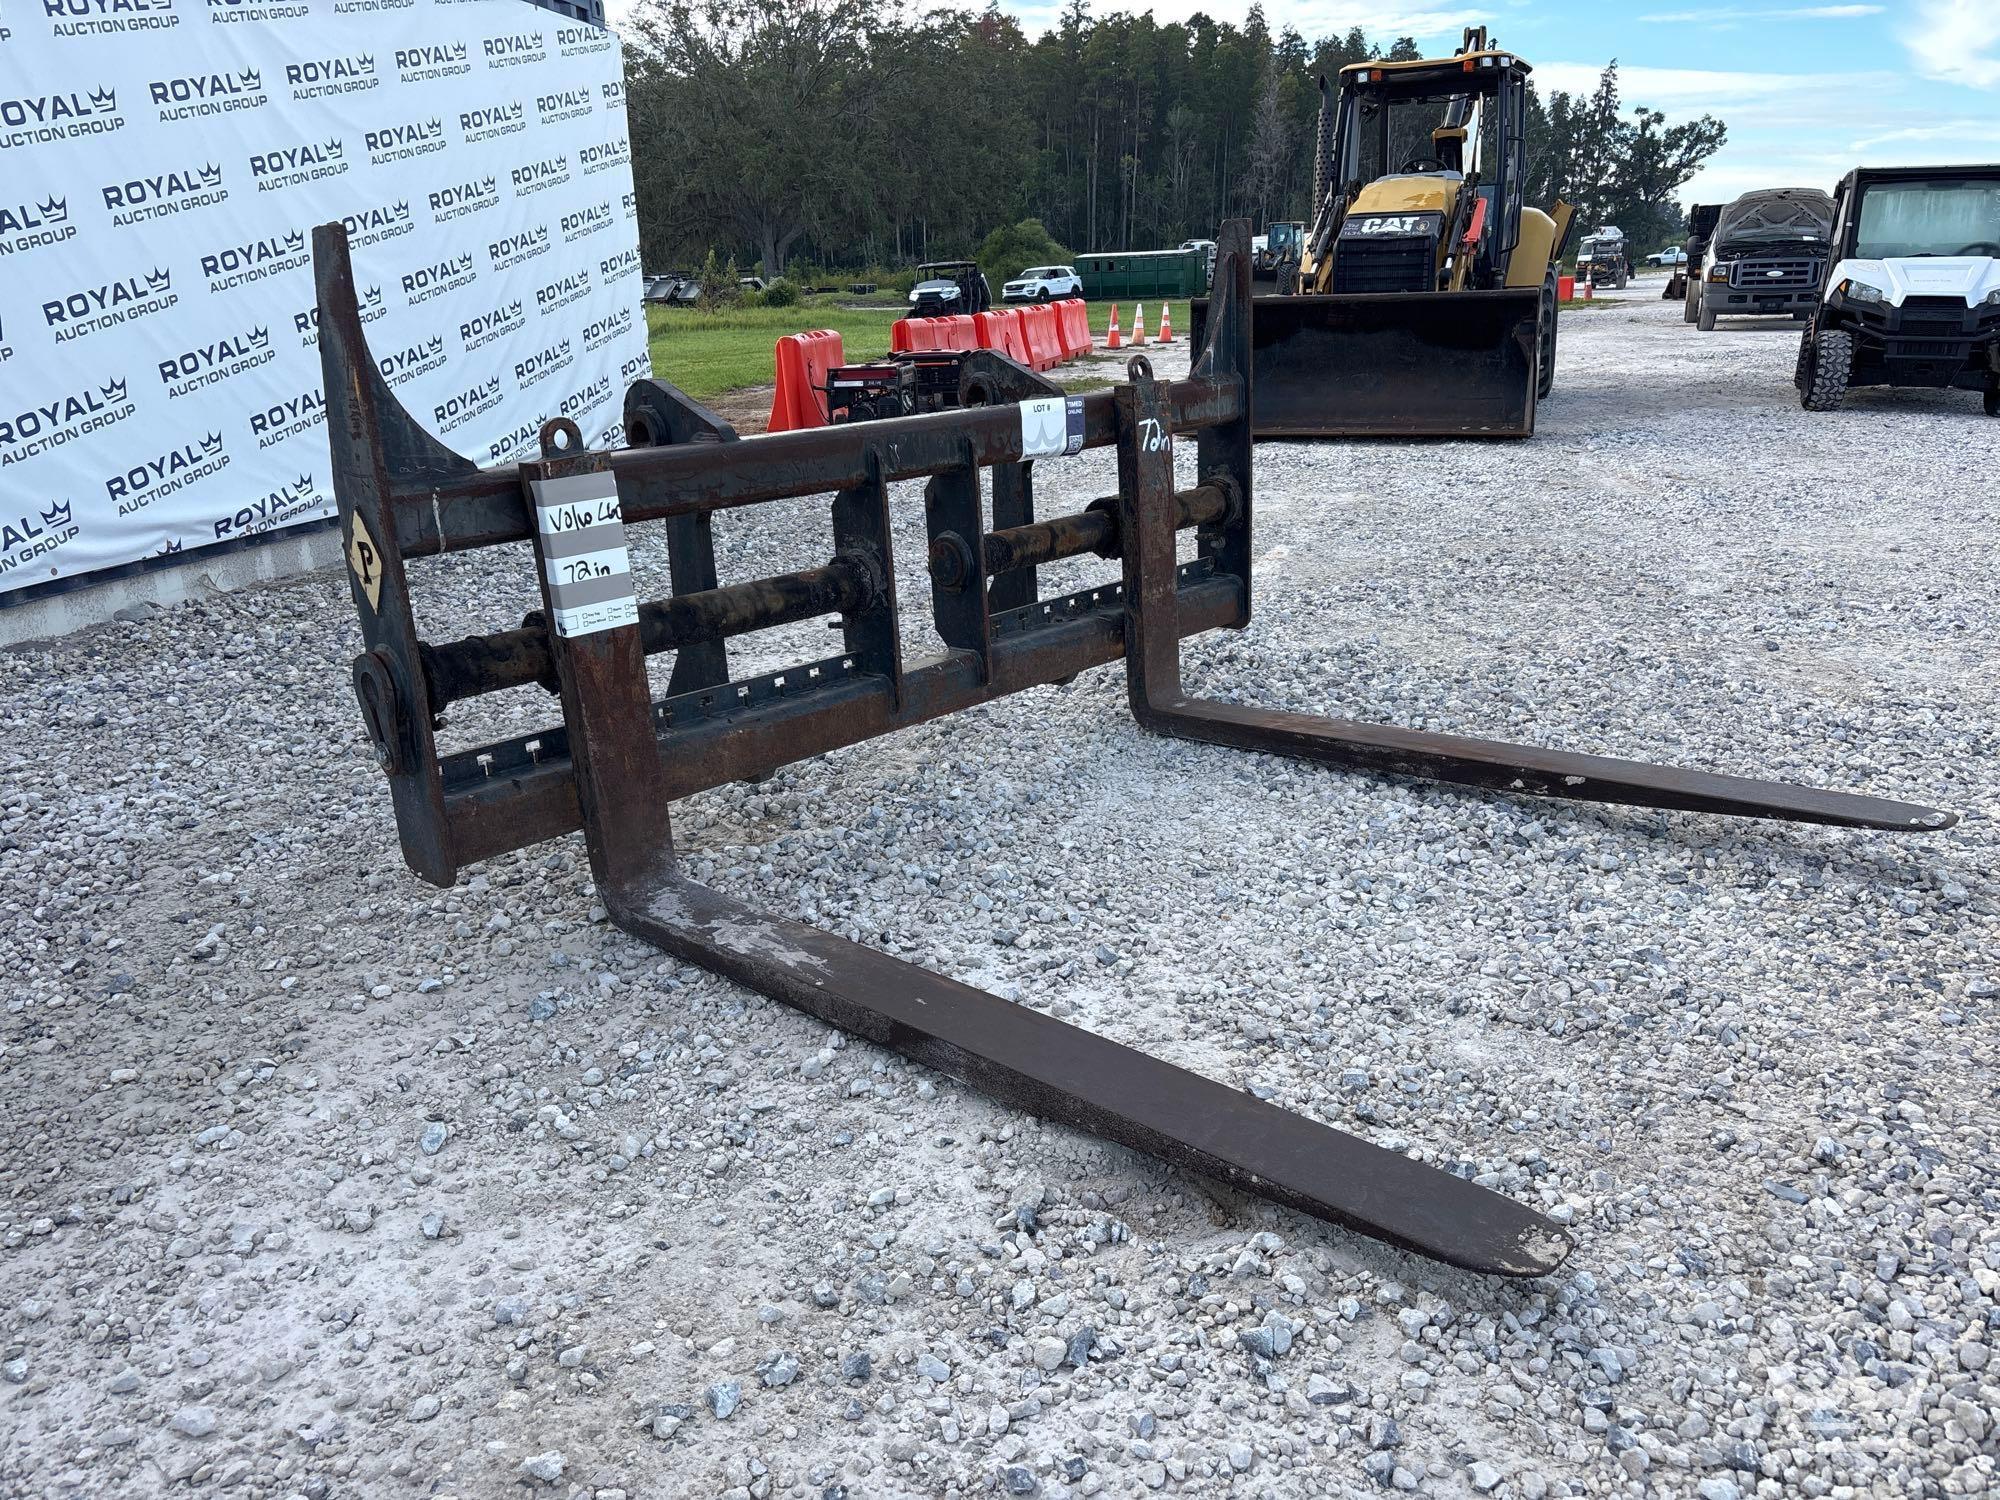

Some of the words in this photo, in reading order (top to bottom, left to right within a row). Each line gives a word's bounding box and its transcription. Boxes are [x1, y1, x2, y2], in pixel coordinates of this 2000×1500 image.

[212, 8, 269, 24] AUCTION
[268, 5, 309, 19] GROUP
[334, 0, 380, 14] AUCTION
[53, 19, 126, 37] AUCTION
[127, 15, 180, 31] GROUP
[556, 23, 600, 45] ROYAL
[394, 44, 455, 69] ROYAL
[482, 34, 533, 57] ROYAL
[488, 56, 522, 69] AUCTION
[521, 51, 547, 64] GROUP
[561, 45, 590, 57] AUCTION
[589, 42, 611, 53] GROUP
[285, 57, 360, 85] ROYAL
[400, 68, 441, 83] AUCTION
[441, 63, 471, 77] GROUP
[148, 73, 242, 105] ROYAL
[293, 83, 343, 101] AUCTION
[343, 77, 379, 93] GROUP
[536, 90, 580, 113] ROYAL
[602, 80, 625, 99] ROY
[606, 98, 626, 110] AUCTIO
[0, 93, 92, 129] OYAL
[159, 102, 222, 122] AUCTION
[222, 95, 268, 112] GROUP
[459, 105, 512, 131] ROYAL
[541, 111, 571, 125] AUCTION
[570, 105, 593, 118] GROUP
[0, 126, 66, 149] UCTION
[67, 117, 125, 137] GROUP
[364, 122, 429, 152] ROYAL
[465, 127, 500, 144] AUCTION
[500, 121, 526, 135] GROUP
[249, 144, 328, 177] ROYAL
[371, 147, 415, 166] AUCTION
[414, 140, 447, 156] GROUP
[579, 141, 620, 165] ROYAL
[583, 161, 610, 176] AUCTION
[609, 154, 629, 166] GROUP
[258, 171, 310, 193] AUCTION
[310, 162, 349, 180] GROUP
[511, 159, 557, 186] ROYAL
[516, 180, 548, 198] AUCTION
[547, 173, 570, 188] GROUP
[101, 170, 202, 210] ROYAL
[428, 181, 484, 211] ROYAL
[113, 201, 179, 228] AUCTION
[180, 189, 229, 211] GROUP
[341, 206, 395, 238] OYAL
[434, 204, 472, 224] AUCTION
[471, 195, 500, 212] GROUP
[560, 206, 602, 233] ROYAL
[15, 225, 77, 251] GROUP
[346, 232, 380, 251] CTION
[380, 222, 415, 240] GROUP
[564, 226, 592, 244] AUCTION
[591, 217, 614, 233] GROUP
[1361, 216, 1420, 233] CAT
[200, 237, 286, 278] ROYAL
[488, 230, 538, 261] ROYAL
[493, 252, 526, 273] AUCTION
[526, 242, 551, 259] GROUP
[210, 266, 268, 294] AUCTION
[268, 253, 311, 276] GROUP
[401, 259, 461, 293] ROYAL
[599, 248, 637, 275] ROYAL
[604, 268, 630, 286] AUCTION
[629, 262, 641, 274] GRO
[41, 277, 149, 326] ROYAL
[408, 284, 448, 307] AUCTION
[447, 272, 477, 291] GROUP
[535, 275, 580, 306] ROYAL
[540, 297, 570, 316] AUCTION
[569, 285, 592, 302] GROUP
[55, 310, 125, 344] AUCTION
[126, 294, 179, 320] GROUP
[359, 307, 387, 325] ROUP
[459, 306, 511, 341] ROYAL
[582, 313, 621, 343] ROYAL
[465, 329, 500, 353] AUCTION
[499, 317, 526, 336] GROUP
[585, 333, 612, 353] AUCTION
[611, 322, 632, 339] GROUP
[158, 336, 250, 384] ROYAL
[169, 366, 230, 400] AUCTION
[230, 349, 276, 375] GROUP
[379, 344, 430, 377] OYAL
[385, 369, 415, 393] CTION
[415, 354, 447, 376] GROUP
[514, 346, 561, 380] ROYAL
[519, 368, 550, 391] AUCTION
[550, 354, 574, 374] GROUP
[621, 352, 649, 378] ROYA
[433, 384, 489, 424] ROYAL
[559, 380, 601, 416] ROYAL
[568, 405, 592, 422] UCTION
[591, 390, 613, 409] GROUP
[1033, 404, 1046, 413] LOT
[1067, 400, 1083, 408] TIMED
[440, 408, 476, 436] AUCTION
[476, 393, 504, 415] GROUP
[1, 426, 79, 467] AUCTION
[80, 403, 136, 434] GROUP
[259, 417, 312, 450] AUCTION
[489, 423, 537, 460] ROYAL
[527, 437, 540, 450] GRO
[602, 423, 625, 445] ROY
[105, 439, 203, 502] ROYAL
[118, 477, 183, 518] AUCTION
[183, 455, 230, 485] GROUP
[214, 487, 299, 539] ROYAL
[279, 495, 323, 522] GROUP
[20, 525, 80, 563] GROUP
[356, 541, 373, 585] P
